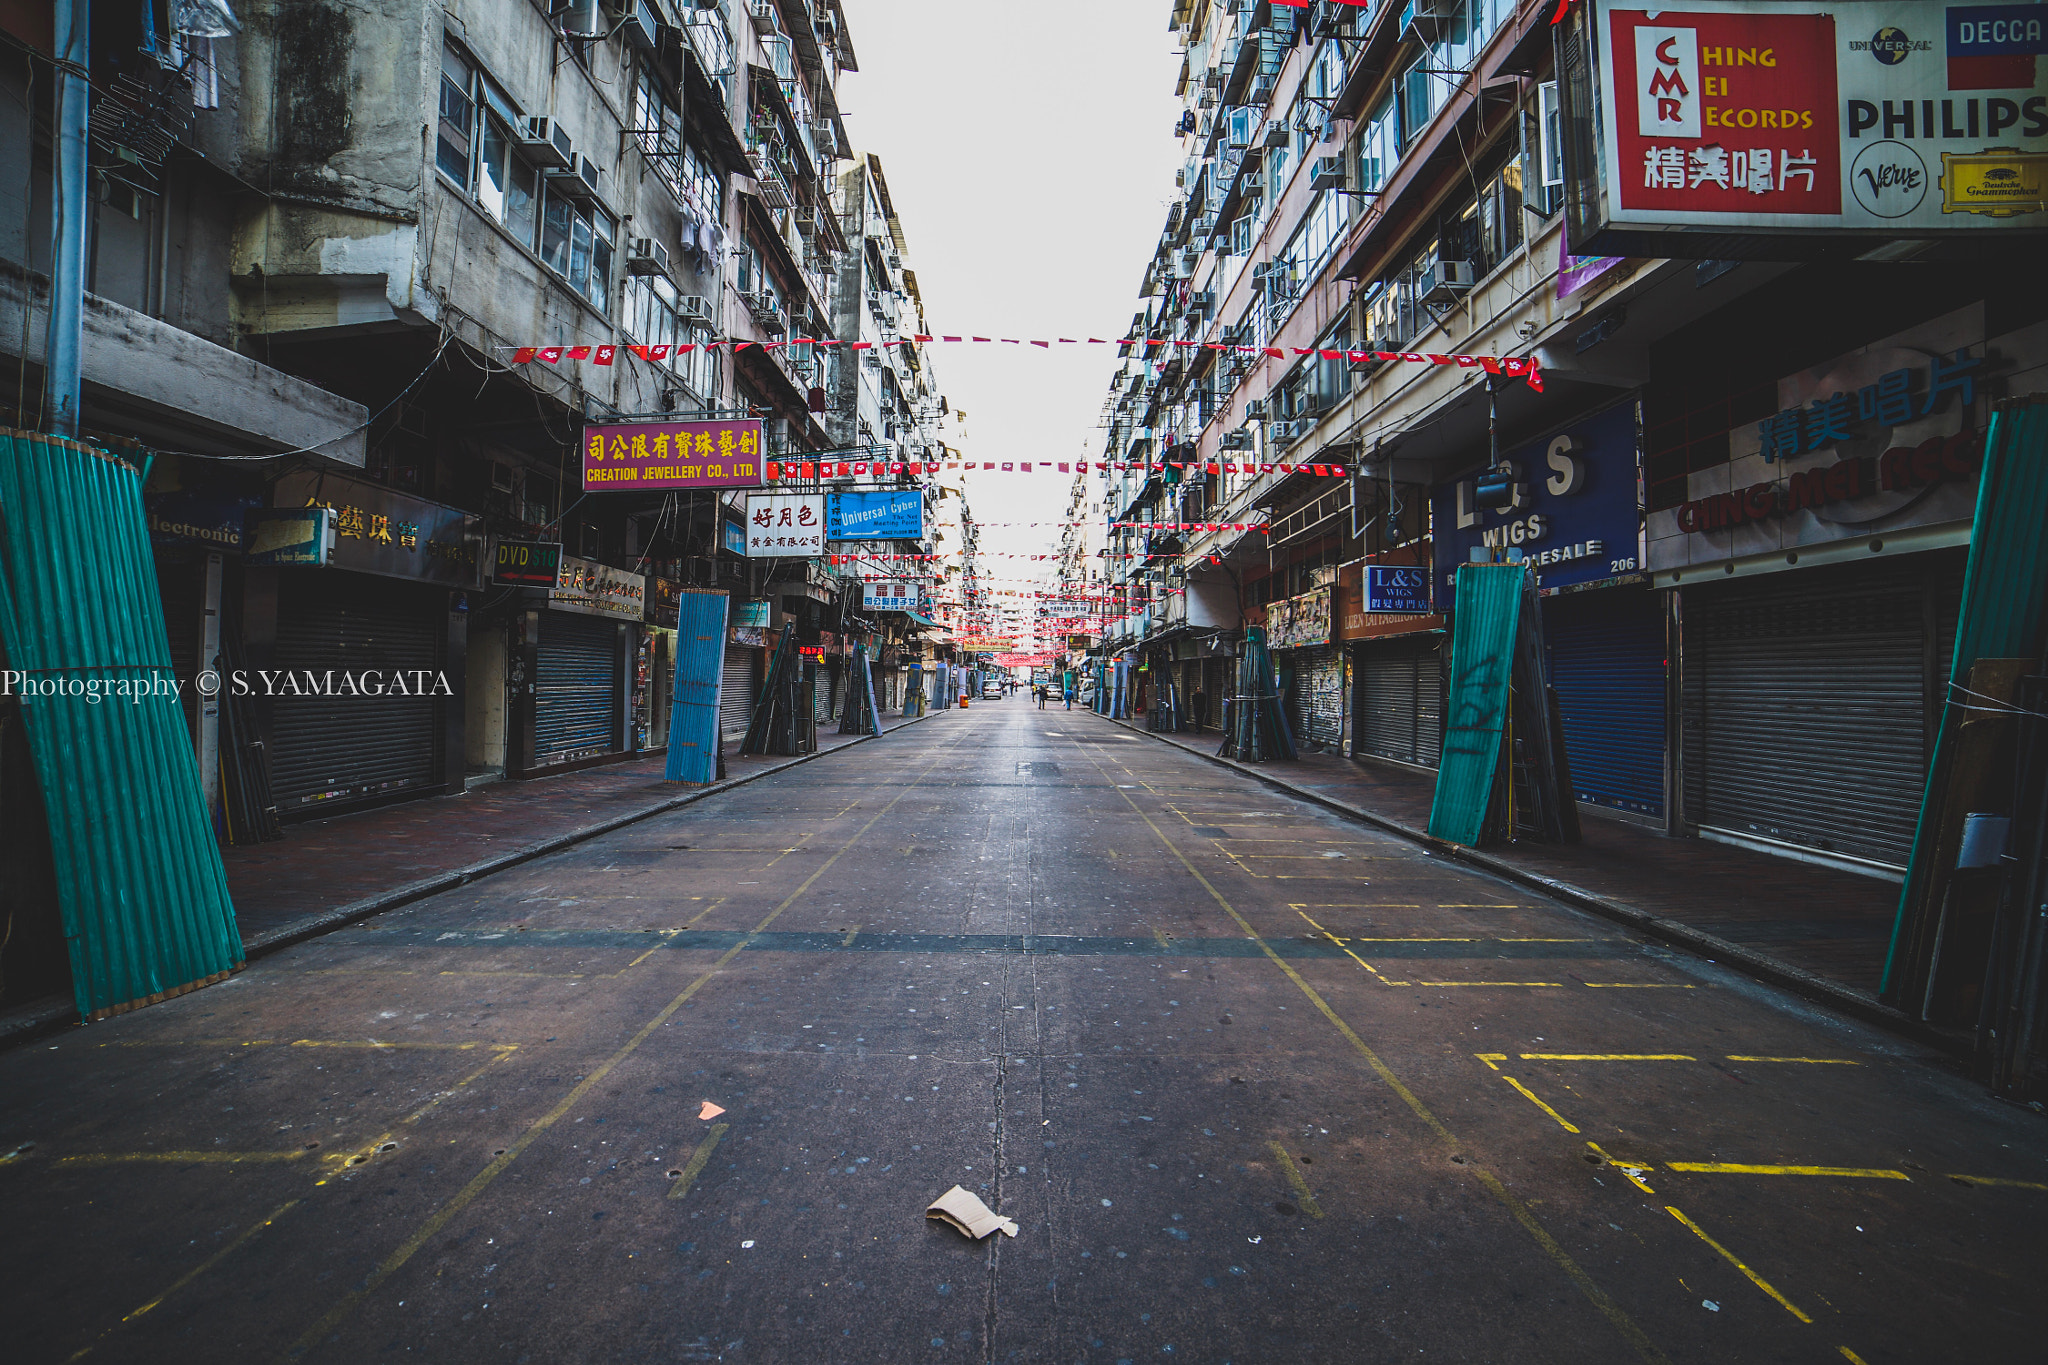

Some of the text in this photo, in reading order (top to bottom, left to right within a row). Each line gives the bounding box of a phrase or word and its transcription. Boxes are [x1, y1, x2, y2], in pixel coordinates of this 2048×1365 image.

[1959, 19, 2042, 44] DECCA
[1849, 40, 1930, 51] UNIVERSAL
[1847, 96, 2048, 139] PHILIPS
[1643, 145, 1817, 194] 精美唱片
[1857, 163, 1922, 200] Verve
[1966, 185, 2039, 197] Grammophon
[1982, 181, 2021, 189] Deutsche
[1758, 348, 1984, 464] 精美唱片
[587, 463, 757, 482] CREATION JEWELLERY CO., LTD.
[1546, 434, 1580, 496] S
[1677, 483, 1775, 534] CHING
[1787, 457, 1862, 512] MEI
[752, 505, 818, 529] 好月色
[841, 501, 918, 527] Universal Cyber
[147, 511, 240, 545] lectronic
[1482, 514, 1544, 548] WIGS
[750, 535, 820, 548] 黃金有限公司
[498, 545, 529, 566] DVD
[1521, 540, 1602, 570] OLESALE
[1610, 557, 1636, 573] 206
[1376, 569, 1424, 588] L&S
[1386, 588, 1413, 597] WIGS
